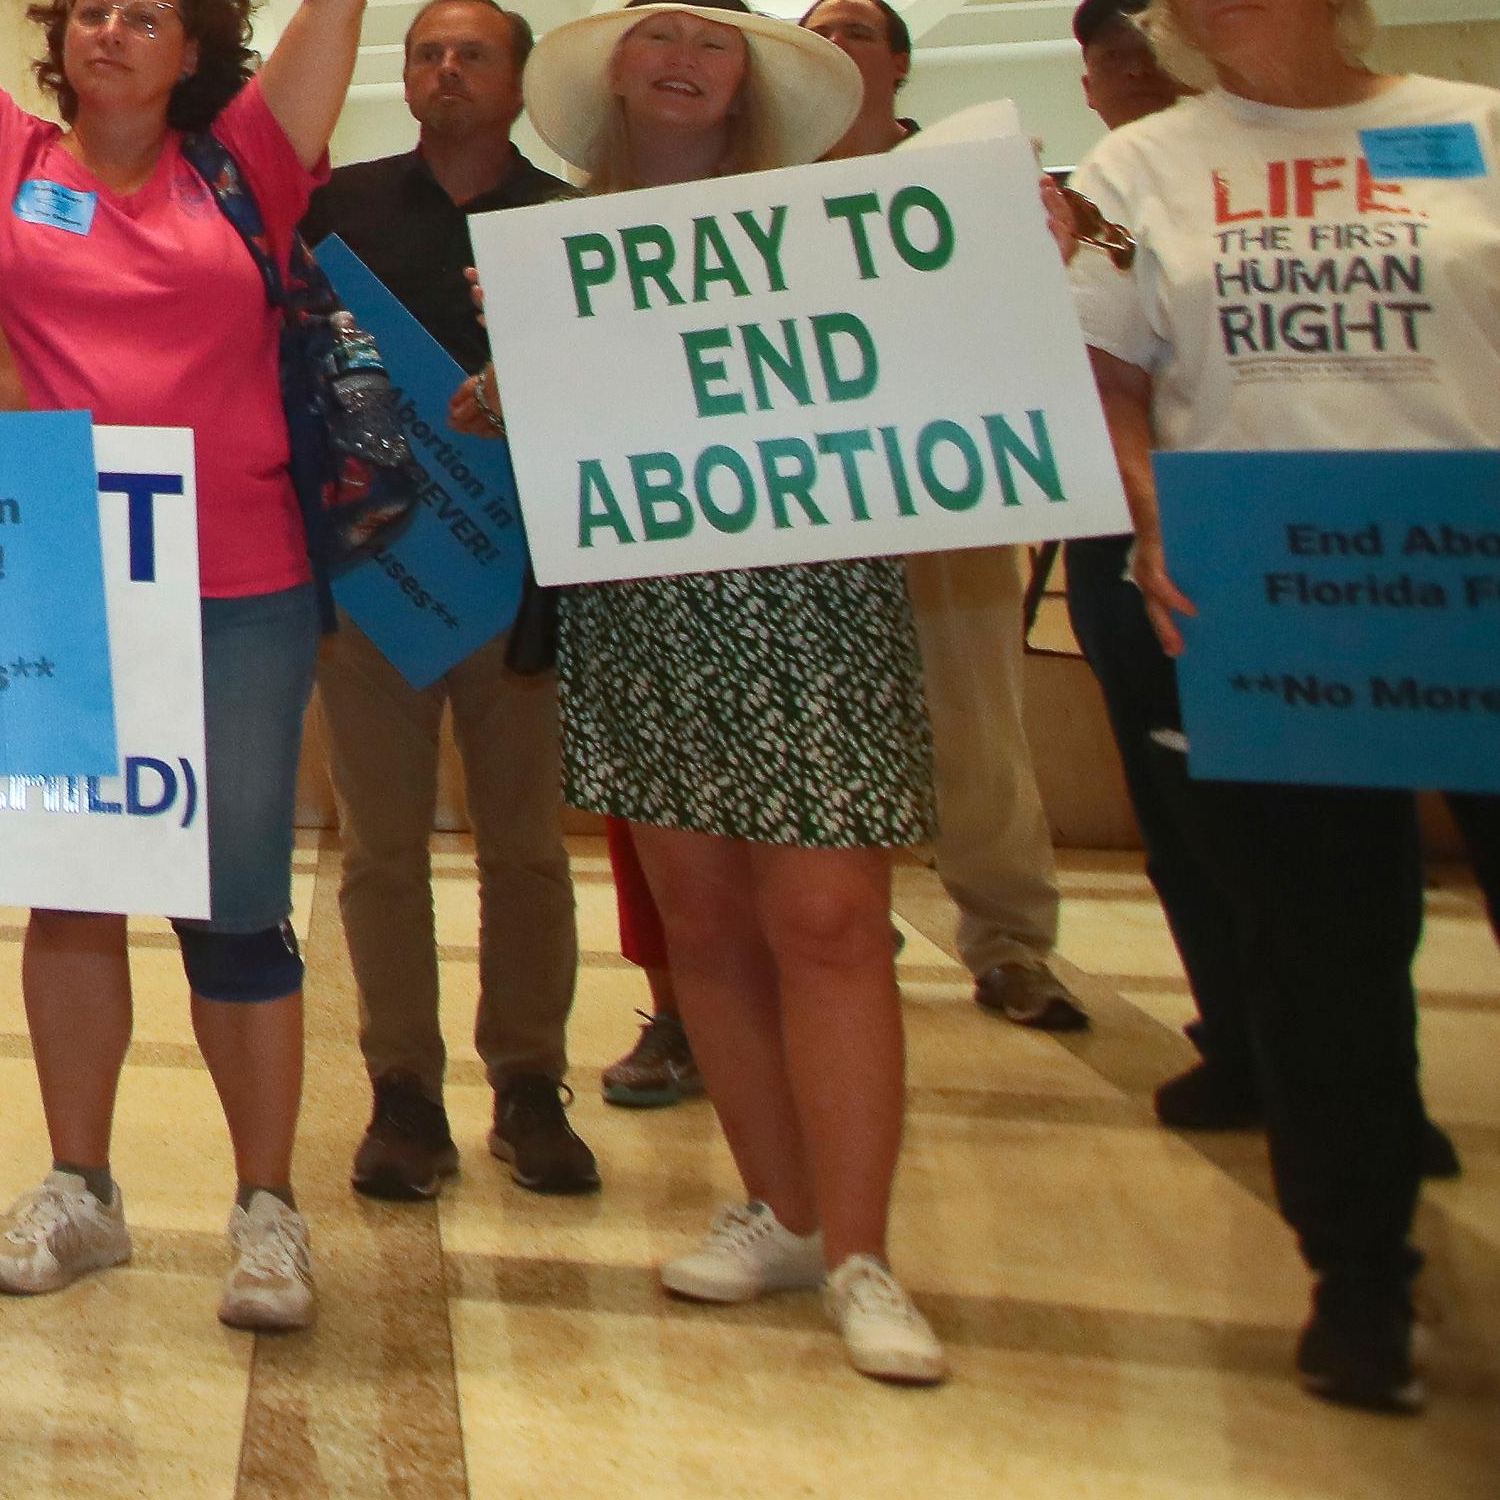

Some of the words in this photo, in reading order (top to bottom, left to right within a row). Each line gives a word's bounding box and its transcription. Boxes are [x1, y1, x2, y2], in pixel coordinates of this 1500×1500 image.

[562, 205, 788, 318] PRAY
[822, 184, 956, 281] TO
[1213, 226, 1292, 253] THE
[1309, 221, 1428, 252] FIRST
[1213, 254, 1423, 298] HUMAN
[1217, 301, 1432, 356] RIGHT
[680, 311, 880, 418] END
[577, 409, 1069, 548] ABORTION
[483, 496, 513, 530] in
[1286, 523, 1384, 557] End
[1264, 571, 1447, 609] Florida
